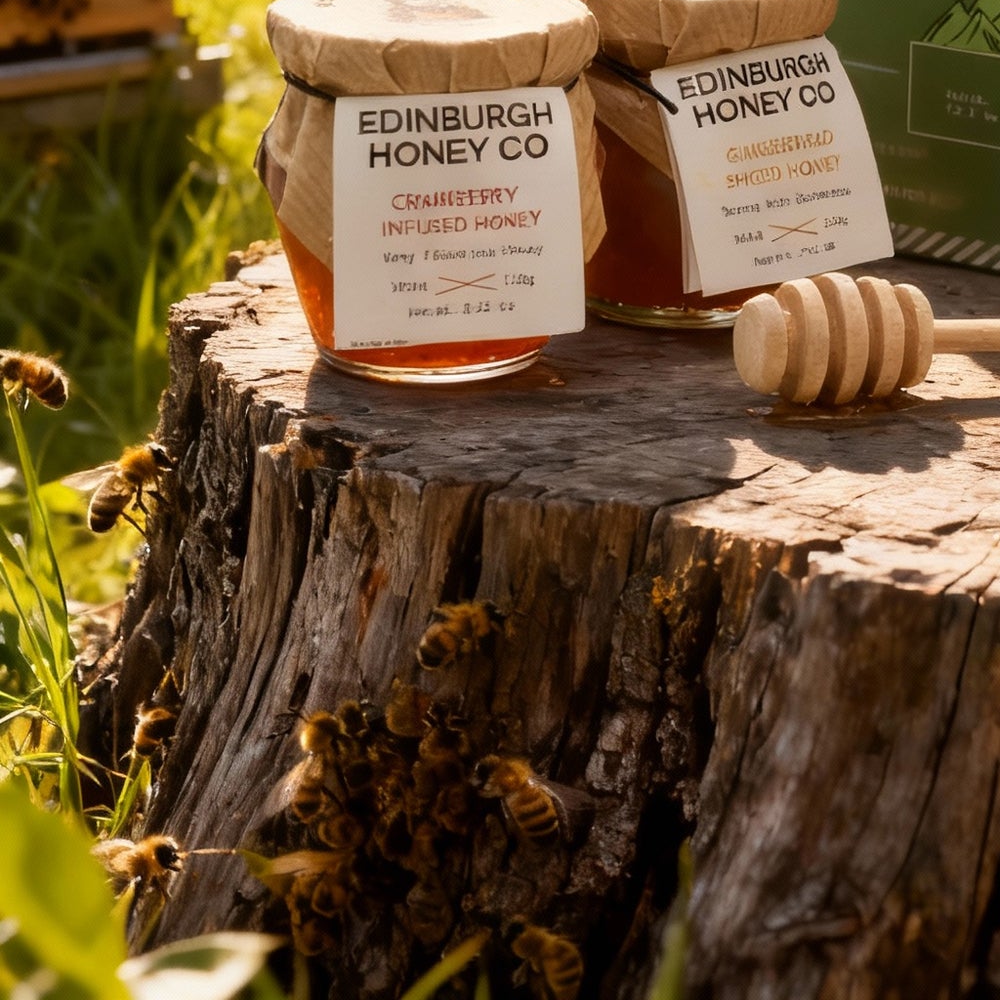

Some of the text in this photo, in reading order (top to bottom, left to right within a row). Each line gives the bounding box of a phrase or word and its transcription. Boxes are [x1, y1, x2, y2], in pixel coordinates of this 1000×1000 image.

[677, 52, 831, 100] EDINBURGH
[358, 101, 553, 135] EDINBURGH
[692, 80, 836, 129] HONEY CO
[369, 134, 549, 168] HONEY CO
[382, 209, 543, 237] INFUSED HONEY
